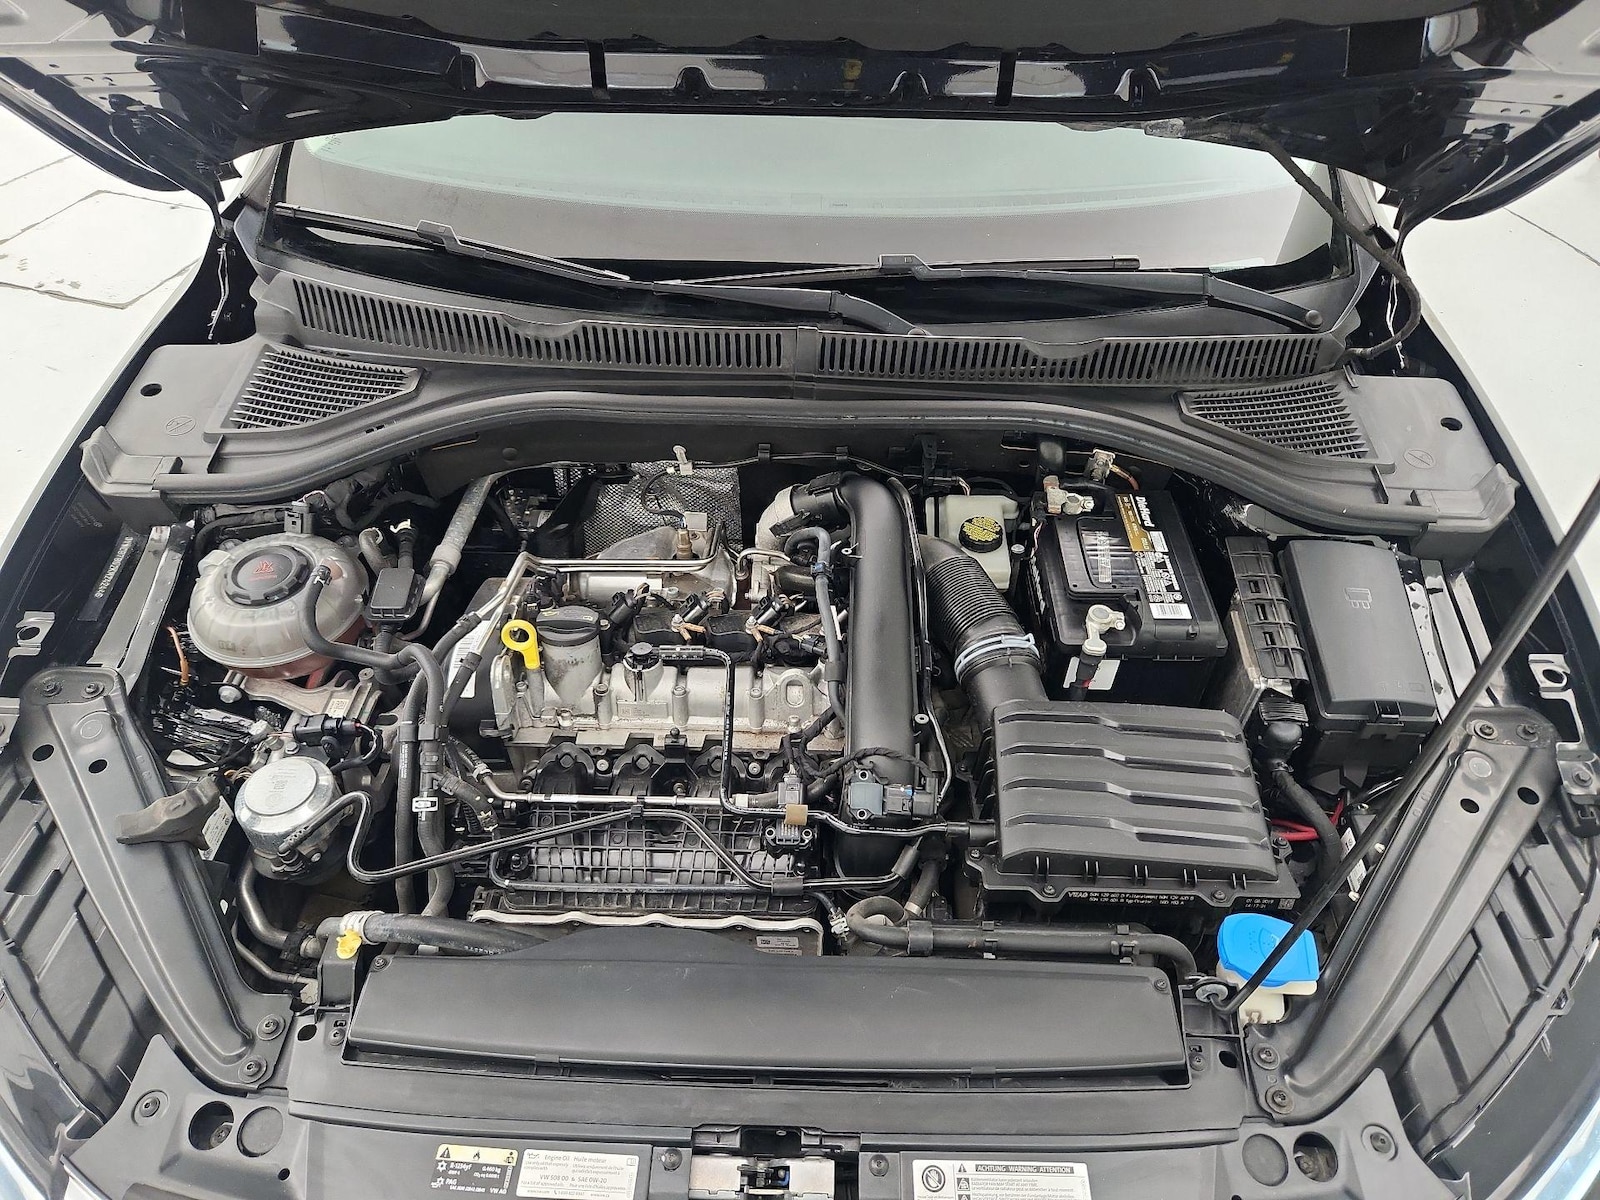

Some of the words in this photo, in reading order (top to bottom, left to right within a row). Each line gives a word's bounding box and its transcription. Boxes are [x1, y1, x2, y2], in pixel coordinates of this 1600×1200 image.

[1136, 496, 1155, 527] DieHard
[449, 1163, 473, 1171] R-1234yf
[1009, 1165, 1037, 1173] WARNING
[1040, 1166, 1071, 1174] ATTENTION
